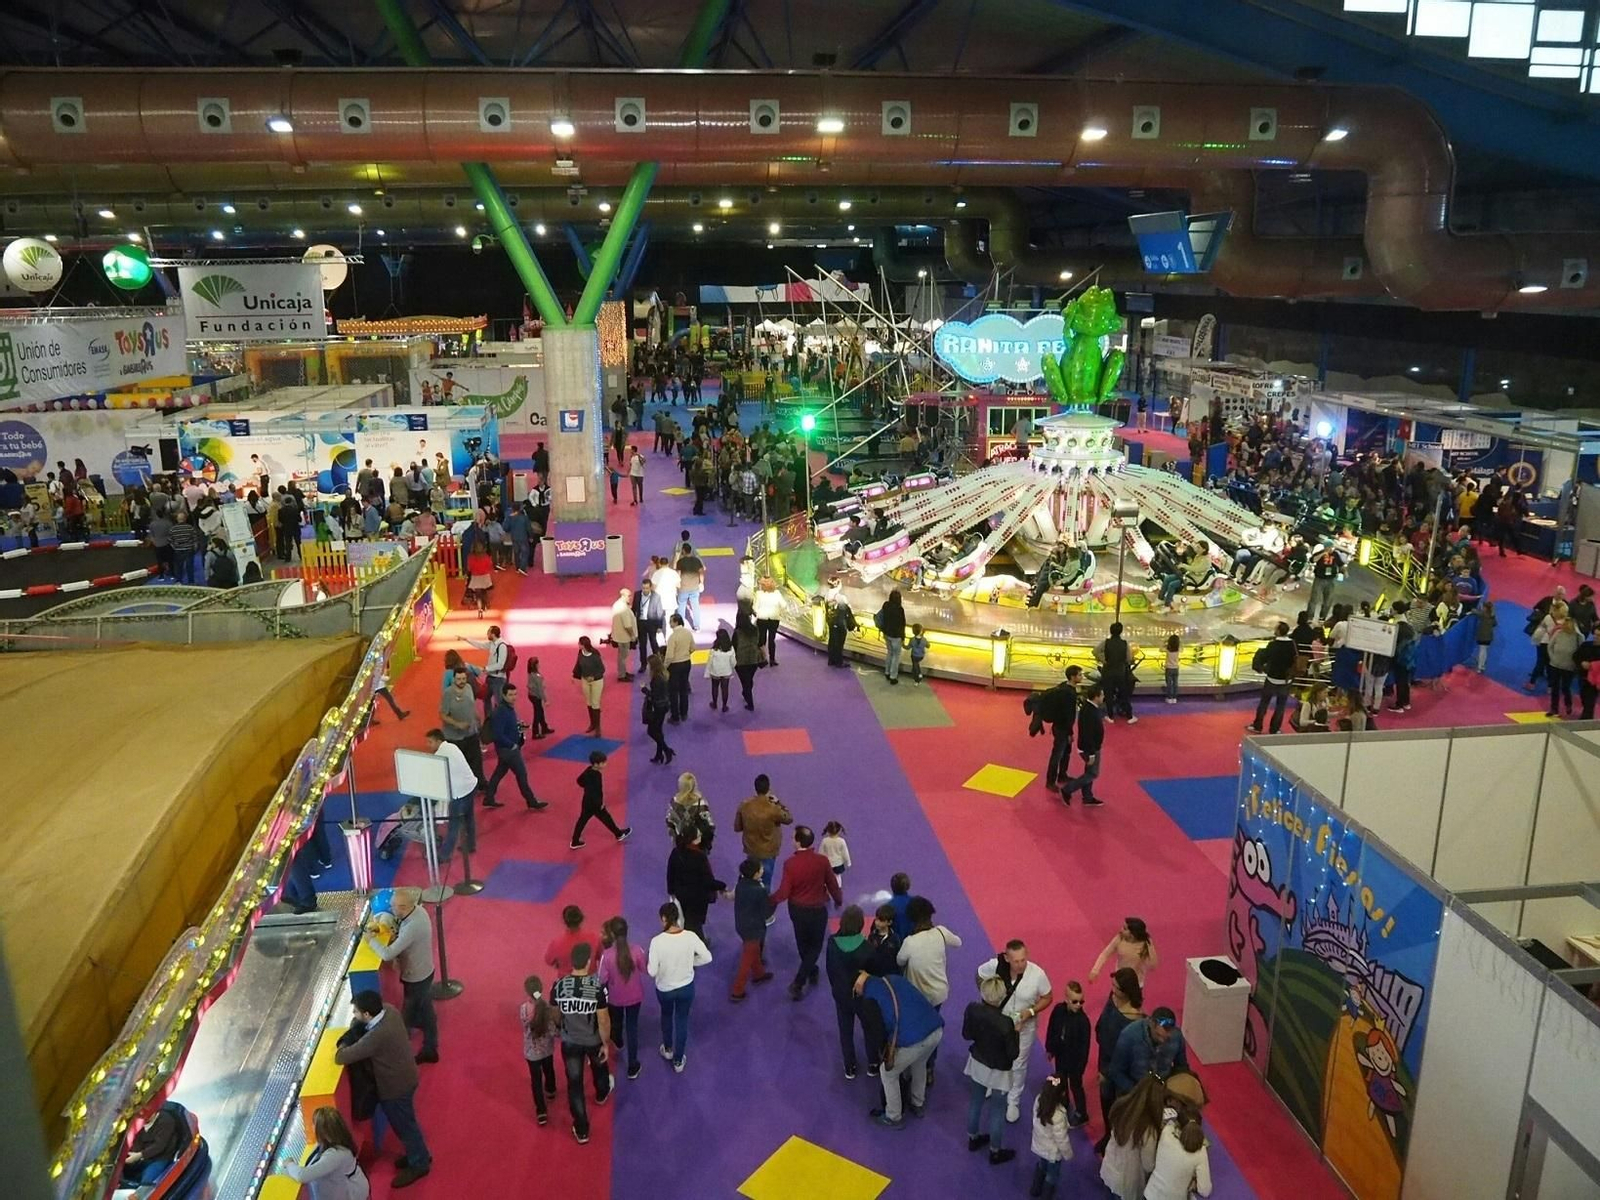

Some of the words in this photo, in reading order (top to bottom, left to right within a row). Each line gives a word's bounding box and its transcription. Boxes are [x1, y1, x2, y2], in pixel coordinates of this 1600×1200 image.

[1178, 242, 1189, 269] 1
[21, 273, 54, 283] Unicaja
[243, 292, 312, 312] Unicaja
[200, 318, 311, 332] Fundación
[17, 341, 47, 360] Unión
[48, 340, 61, 356] de
[943, 333, 1029, 354] RANITA
[22, 361, 87, 384] Consumidores
[2, 432, 24, 440] Todo
[10, 441, 20, 449] tu
[21, 440, 43, 449] bebé
